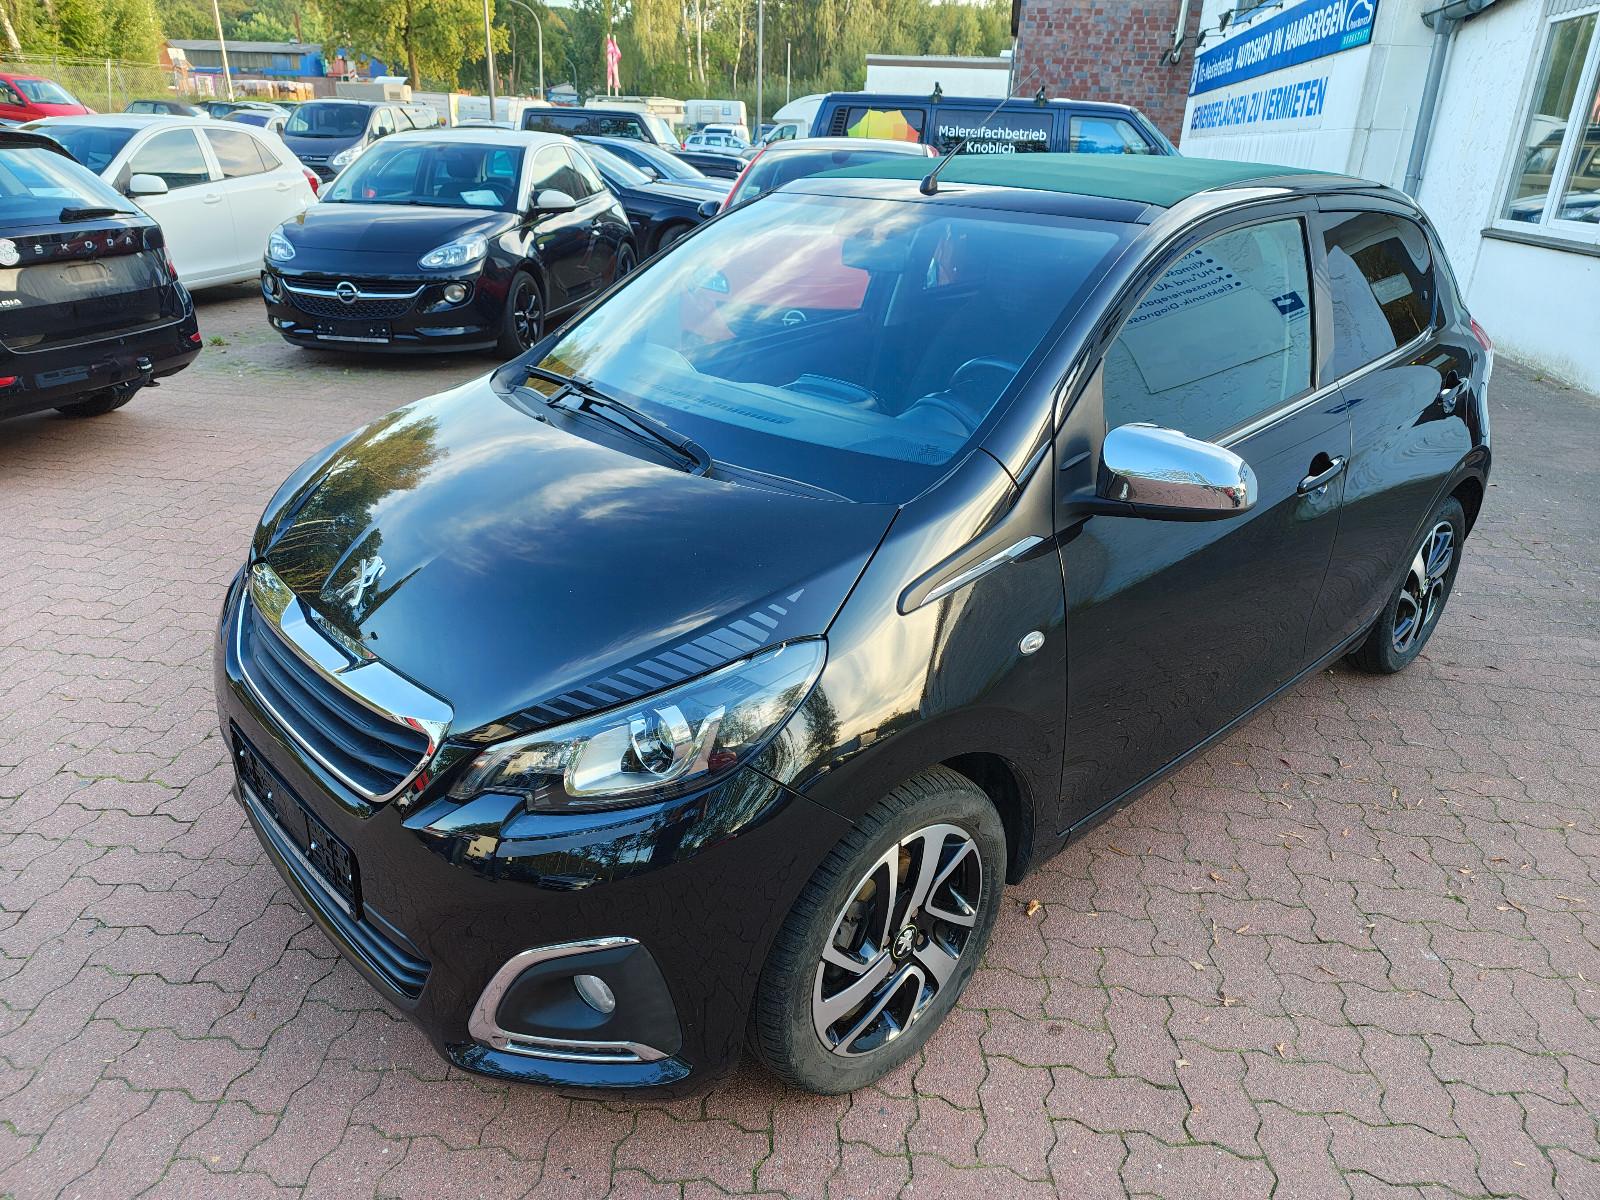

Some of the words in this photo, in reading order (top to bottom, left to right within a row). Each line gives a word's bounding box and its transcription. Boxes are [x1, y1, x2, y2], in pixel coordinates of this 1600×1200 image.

[1235, 31, 1273, 70] AUTOSHOP
[1272, 27, 1285, 56] IN
[1283, 0, 1348, 52] HAMBERGEN
[1247, 90, 1263, 123] ZU
[1262, 76, 1329, 121] VERMIETEN
[938, 125, 1047, 141] Malereifachbetrieb
[966, 141, 1016, 154] Knoblich
